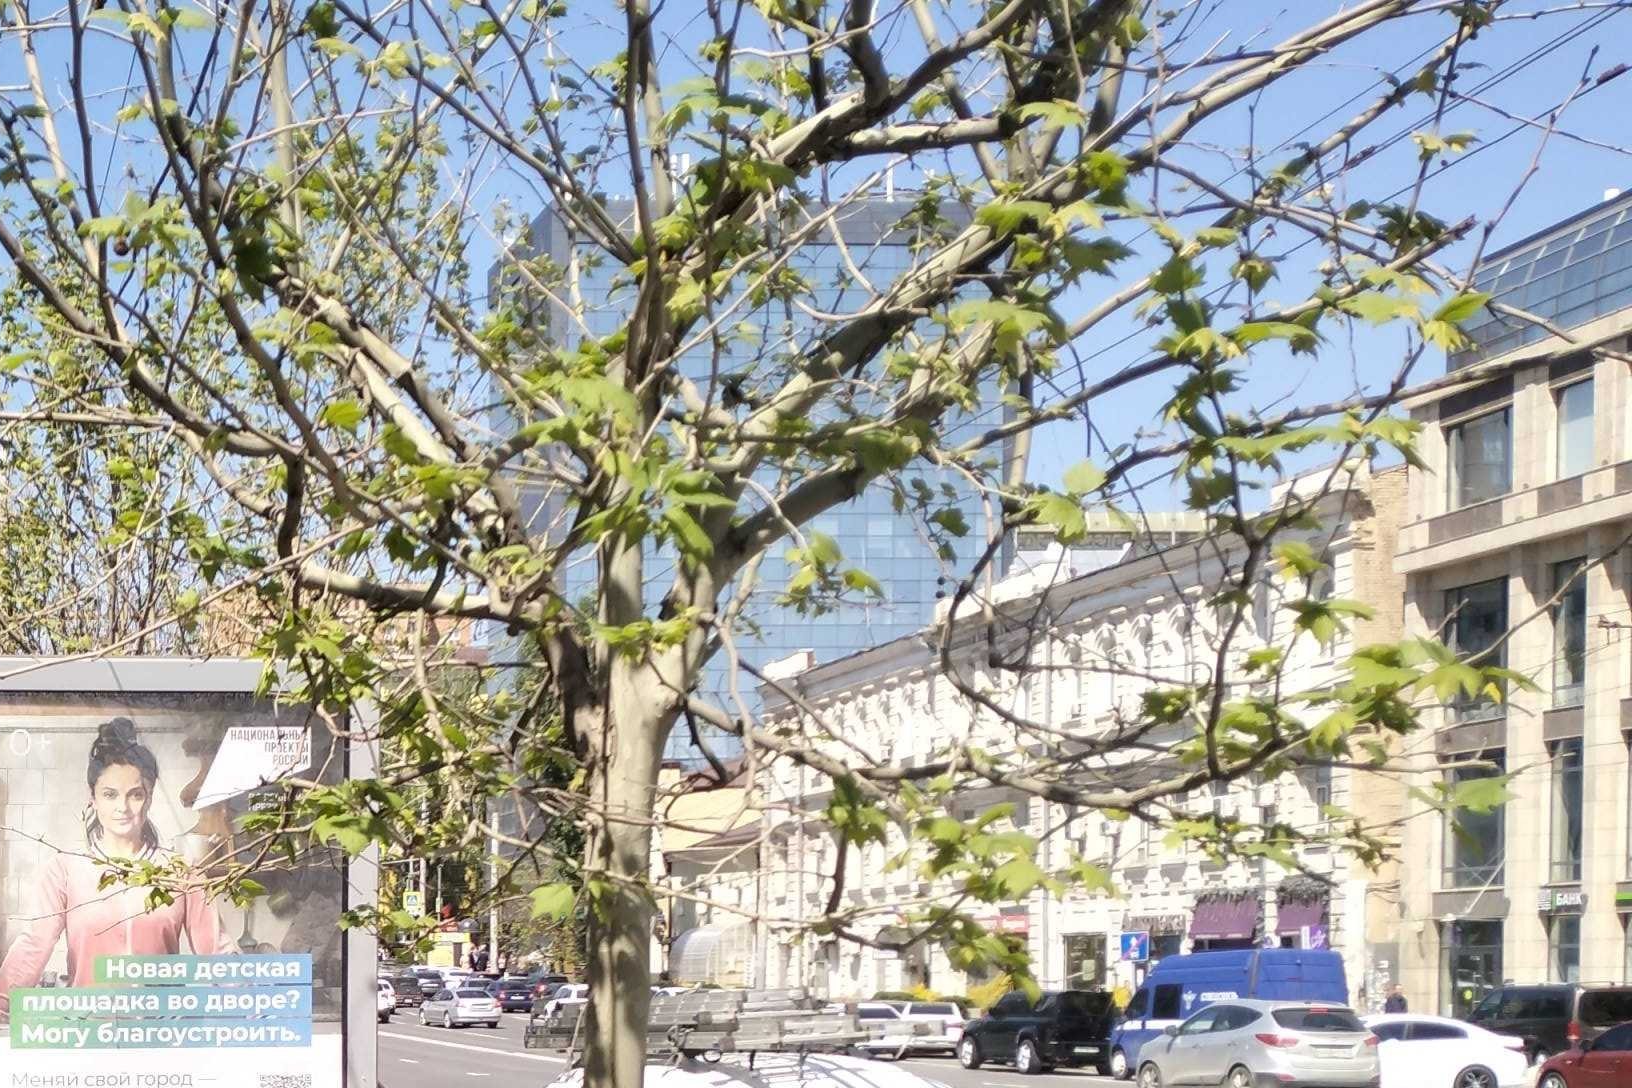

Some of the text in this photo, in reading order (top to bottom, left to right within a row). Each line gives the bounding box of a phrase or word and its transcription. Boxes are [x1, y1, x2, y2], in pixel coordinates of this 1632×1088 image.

[105, 958, 301, 983] Новая детская
[21, 989, 301, 1014] площадка во дворе?
[20, 1021, 301, 1047] Могу благоустроить.
[11, 1072, 79, 1088] Меняй
[84, 1071, 132, 1087] свой
[137, 1073, 194, 1088] город
